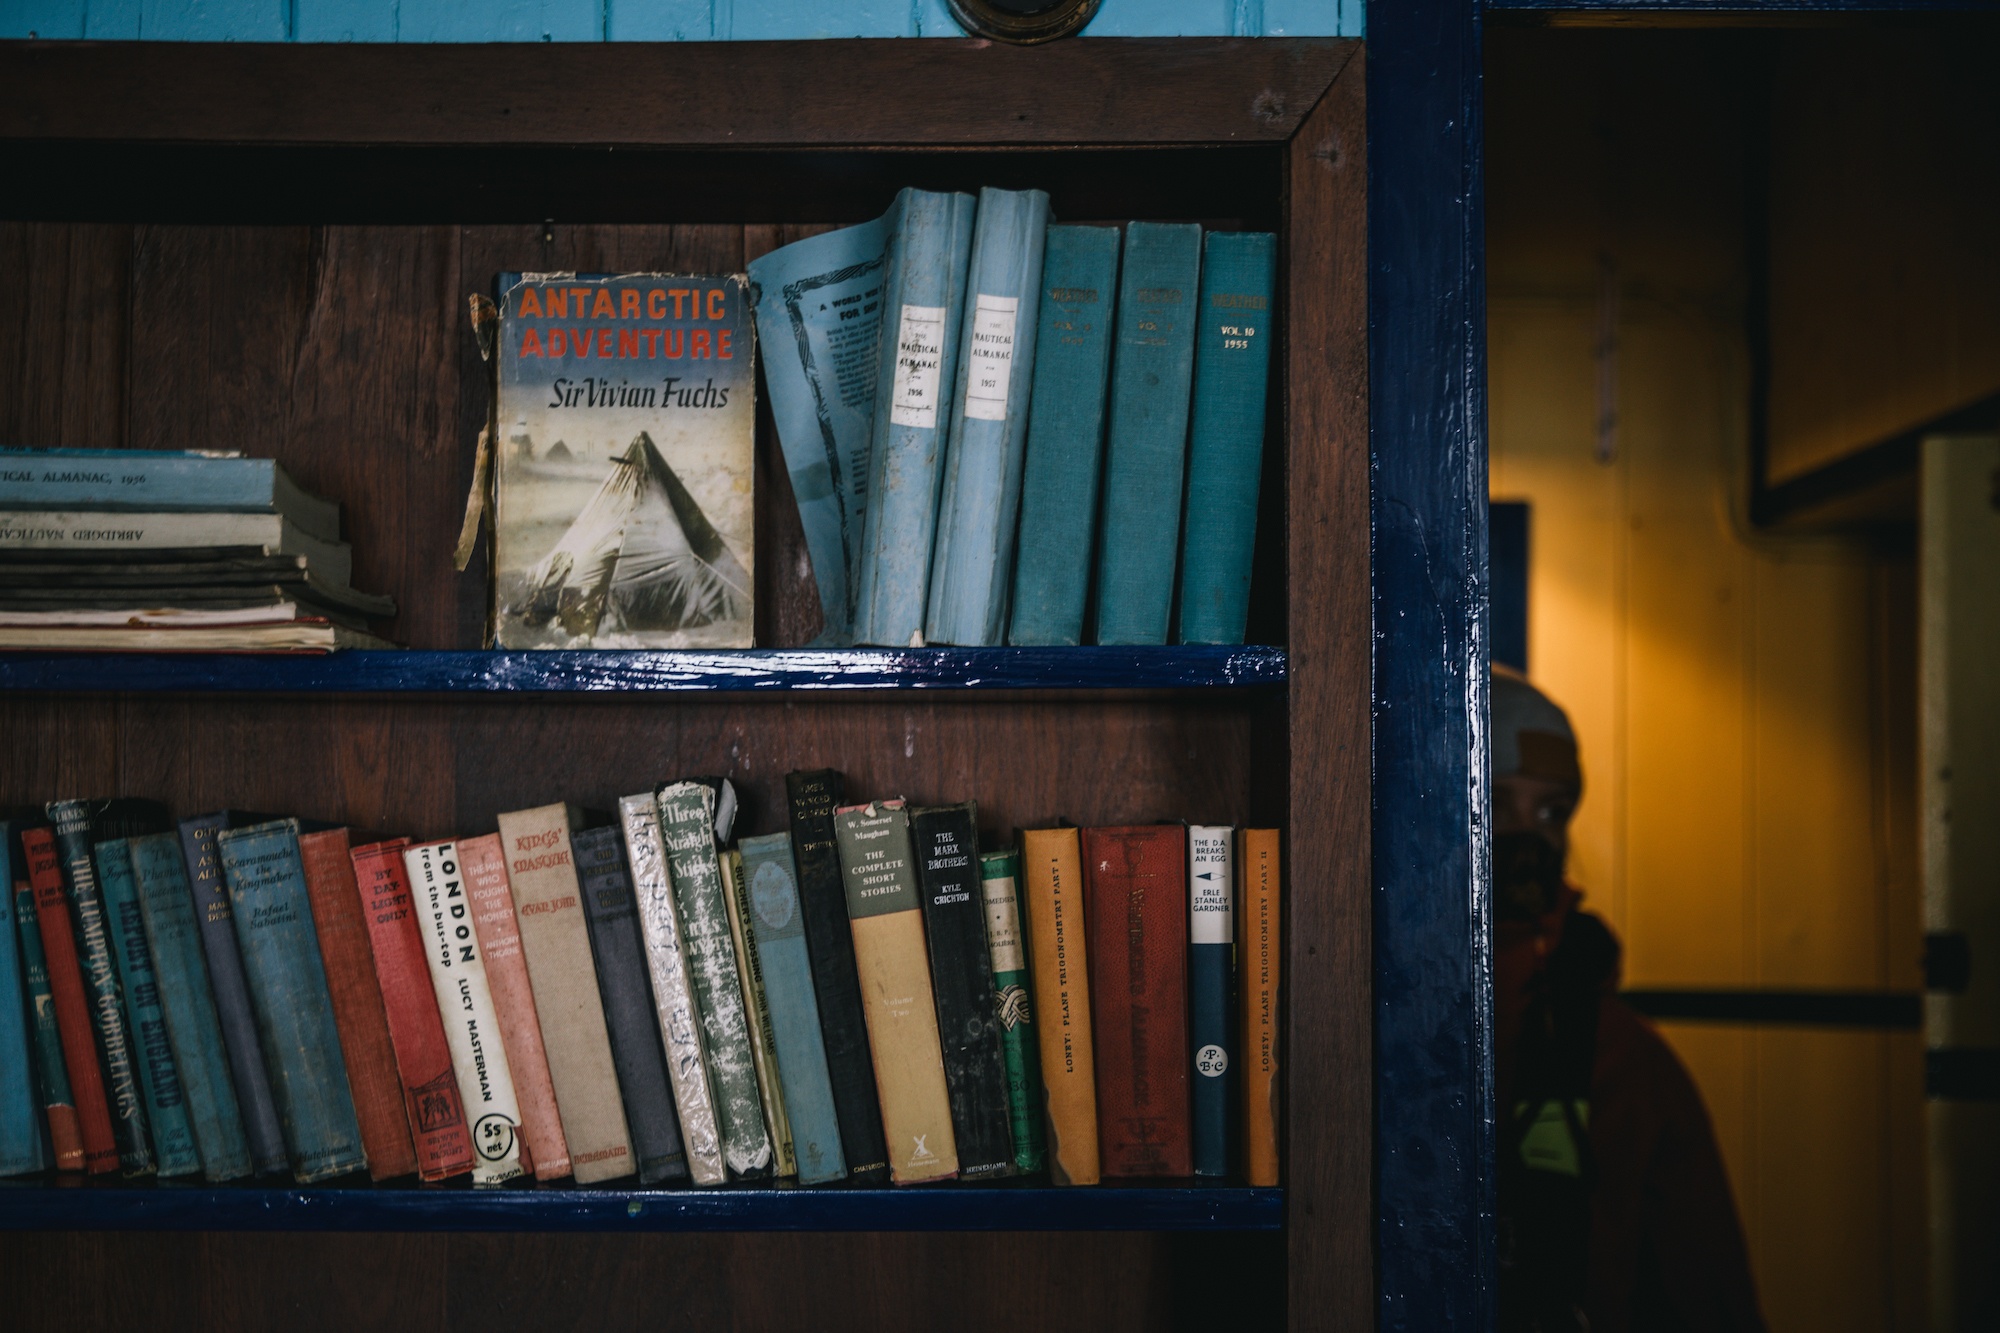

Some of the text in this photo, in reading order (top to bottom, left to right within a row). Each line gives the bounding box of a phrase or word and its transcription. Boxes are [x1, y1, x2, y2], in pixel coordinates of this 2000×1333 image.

[518, 287, 726, 321] ANTARCTIC
[1212, 294, 1268, 310] WEATHER
[840, 308, 861, 322] FOR
[974, 331, 1013, 345] NAUTICAL
[1244, 327, 1255, 337] 10
[519, 328, 734, 360] ADVENTURE
[900, 341, 939, 354] NAUTICAL
[1224, 339, 1248, 349] 1955
[972, 348, 1011, 361] ALMANAC
[899, 357, 939, 370] ALMANAC
[980, 378, 997, 388] 1957
[548, 376, 730, 409] Sir Vivian Fuchs
[907, 387, 924, 397] 1956
[0, 469, 35, 483] ICAL
[72, 529, 145, 542] ABRIDGED
[666, 801, 706, 825] Three
[847, 816, 893, 829] W. Somerset
[854, 829, 890, 841] Maugham
[935, 832, 954, 843] THE
[31, 842, 55, 855] MURDE
[865, 850, 885, 860] THE
[934, 844, 959, 856] MARX
[1261, 851, 1267, 859] II
[34, 858, 57, 874] JIGSA
[227, 847, 294, 871] Scaramouche
[421, 848, 434, 883] from
[927, 856, 968, 871] BROTHERS
[255, 864, 272, 876] the
[468, 860, 504, 876] THE MAN
[851, 859, 904, 875] COMPLETE
[375, 868, 393, 881] BY
[476, 874, 500, 887] WHO
[862, 873, 896, 885] SHORT
[1053, 867, 1061, 894] PART
[235, 871, 294, 893] Kingmaker
[374, 880, 401, 895] DAY-
[941, 884, 961, 893] KYLE
[473, 884, 509, 900] FOUGHT
[860, 884, 902, 898] STORIES
[371, 893, 408, 911] LIGHT
[438, 844, 476, 963] LONDON
[484, 899, 503, 910] THE
[933, 892, 970, 905] CRICHTON
[984, 896, 1015, 906] OMEDIES
[254, 901, 290, 918] Rafael
[376, 908, 409, 924] ONLY
[478, 908, 514, 924] MONKEY
[250, 911, 298, 930] Sabatini
[1054, 899, 1067, 986] TRIGONOMETRY
[735, 865, 776, 1055] BUTCHER'S CROSSING JOHN WILLIAMS
[71, 854, 138, 1119] THE LUMPTON GOBBELINGS
[1062, 991, 1070, 1026] PLANE
[458, 977, 493, 1102] LUCY MASTERMAN
[1065, 1033, 1073, 1073] LONEY:
[141, 1020, 182, 1109] ENGLAND
[487, 1141, 503, 1153] net
[966, 1161, 1007, 1174] HEINEMANN
